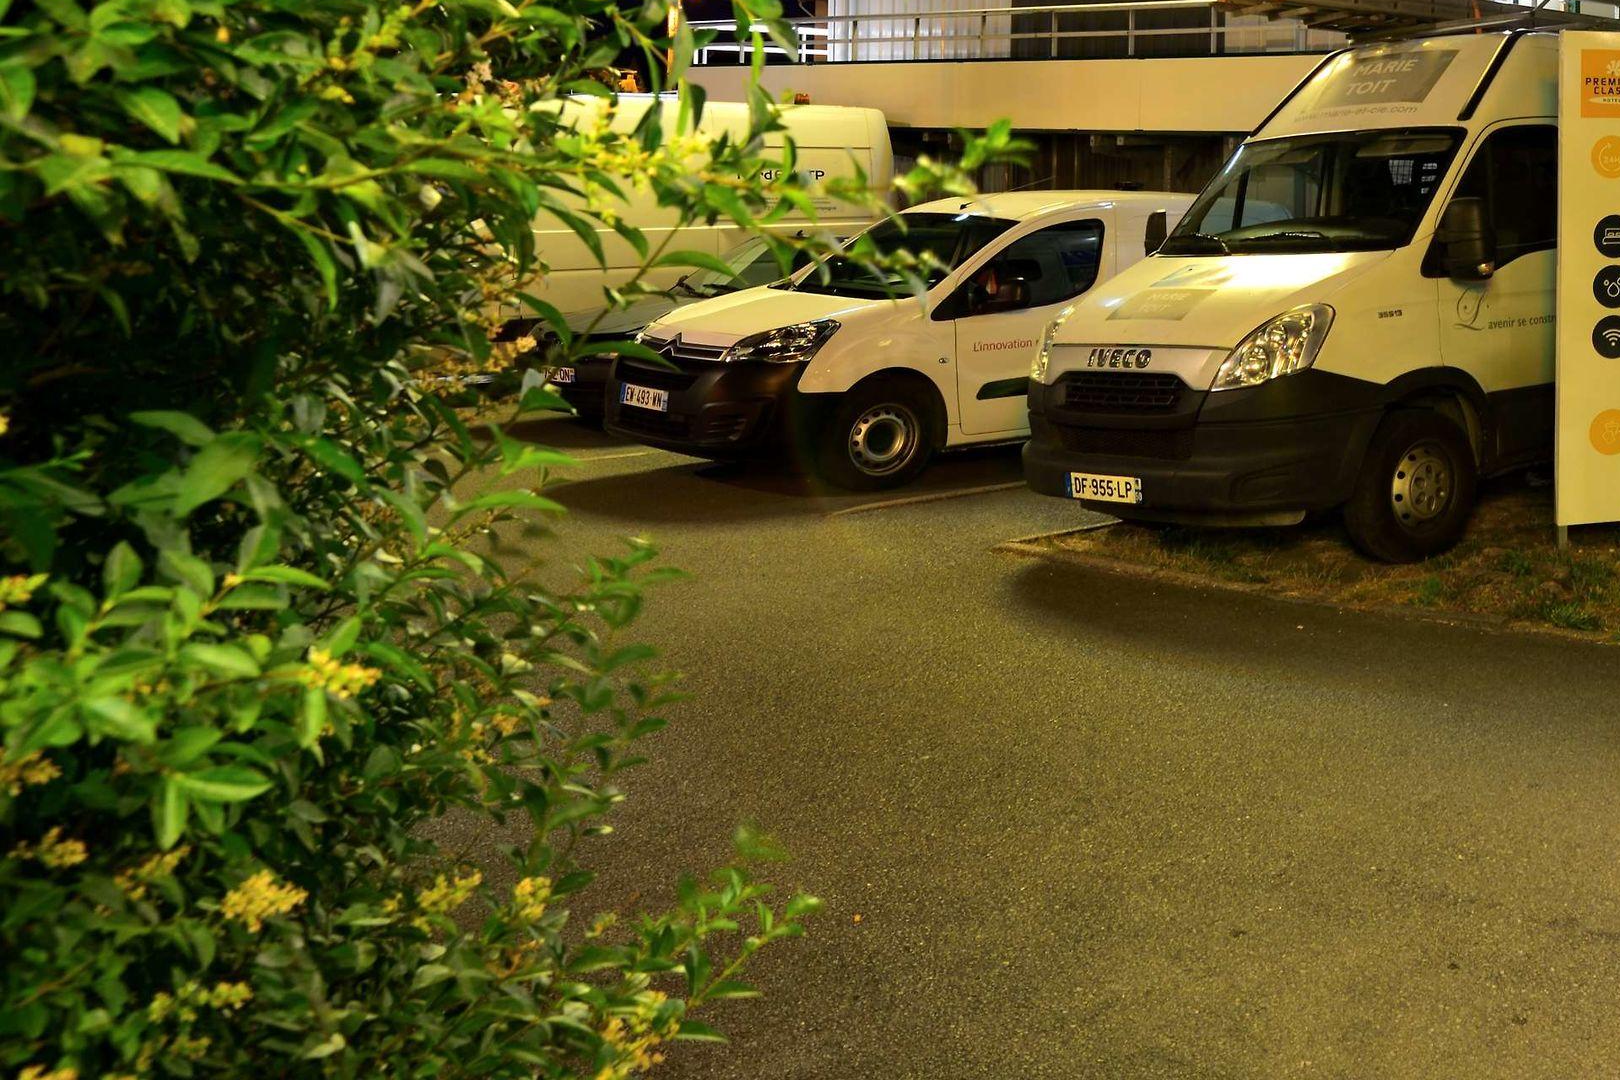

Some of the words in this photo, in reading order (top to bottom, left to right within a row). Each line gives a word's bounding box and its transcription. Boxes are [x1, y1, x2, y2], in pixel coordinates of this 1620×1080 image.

[1353, 59, 1419, 76] MARIE
[1347, 79, 1396, 95] TOIT
[1518, 318, 1526, 327] se
[1529, 315, 1556, 326] constr
[973, 340, 1032, 352] L'innovation
[1087, 348, 1151, 368] IVECO
